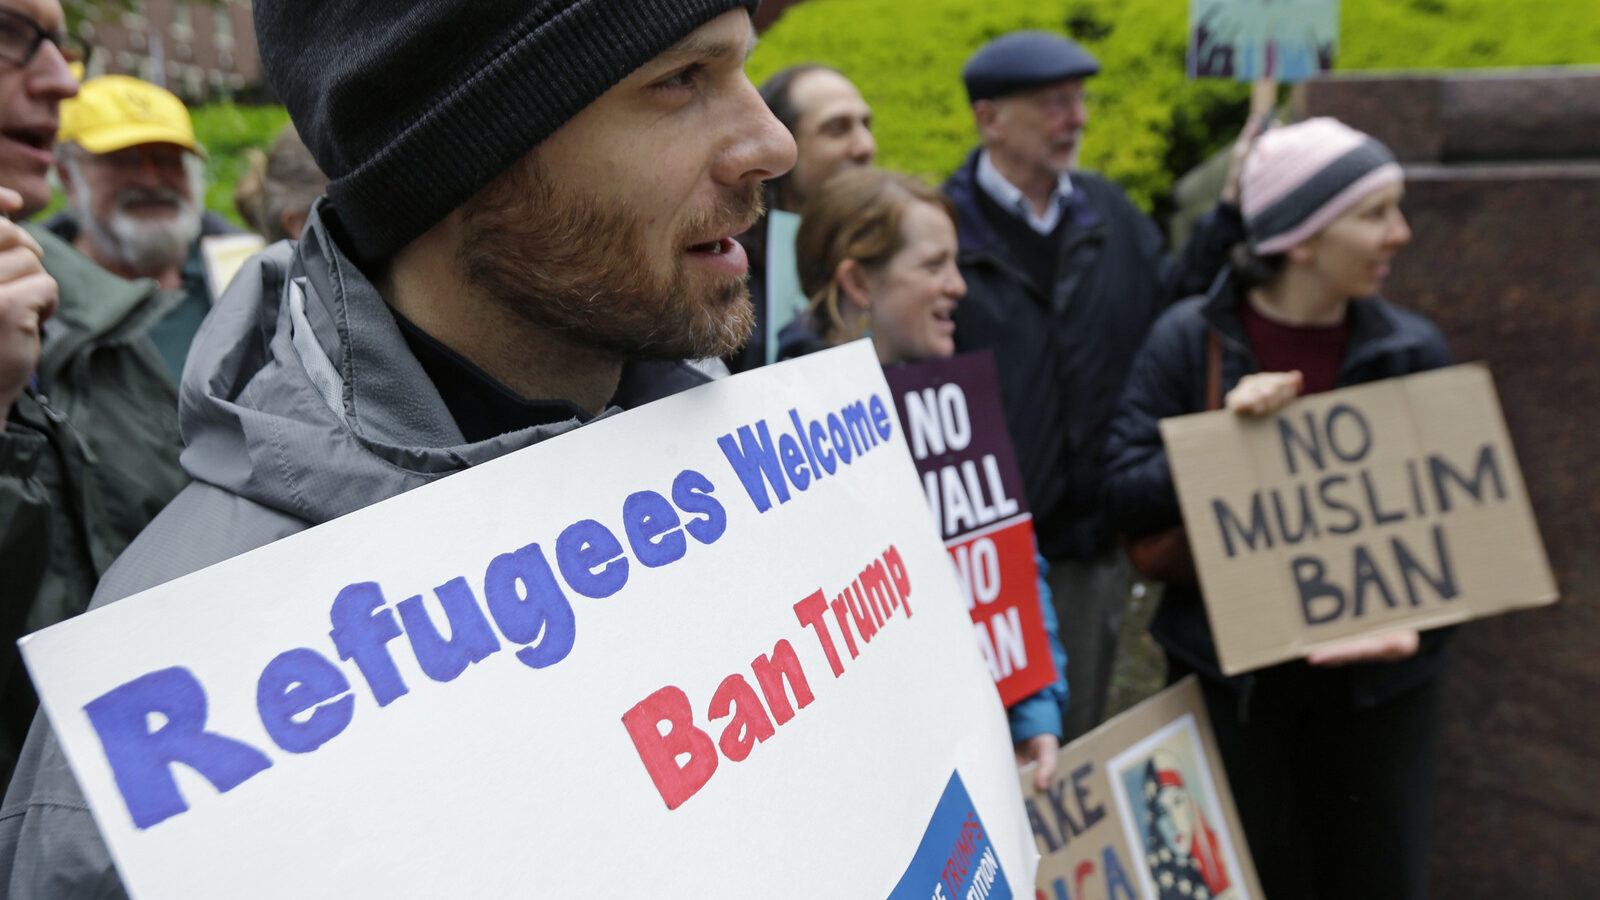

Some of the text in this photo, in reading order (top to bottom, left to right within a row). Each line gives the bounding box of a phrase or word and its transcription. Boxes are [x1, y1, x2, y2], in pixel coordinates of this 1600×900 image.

[904, 382, 973, 460] NO
[1276, 402, 1374, 475] NO
[1211, 442, 1508, 559] MUSLIM
[83, 392, 892, 830] Refugees Welcome
[1291, 525, 1460, 626] BAN
[622, 544, 912, 811] Ban Trump
[974, 605, 1029, 683] AN
[1025, 761, 1107, 853] AKE
